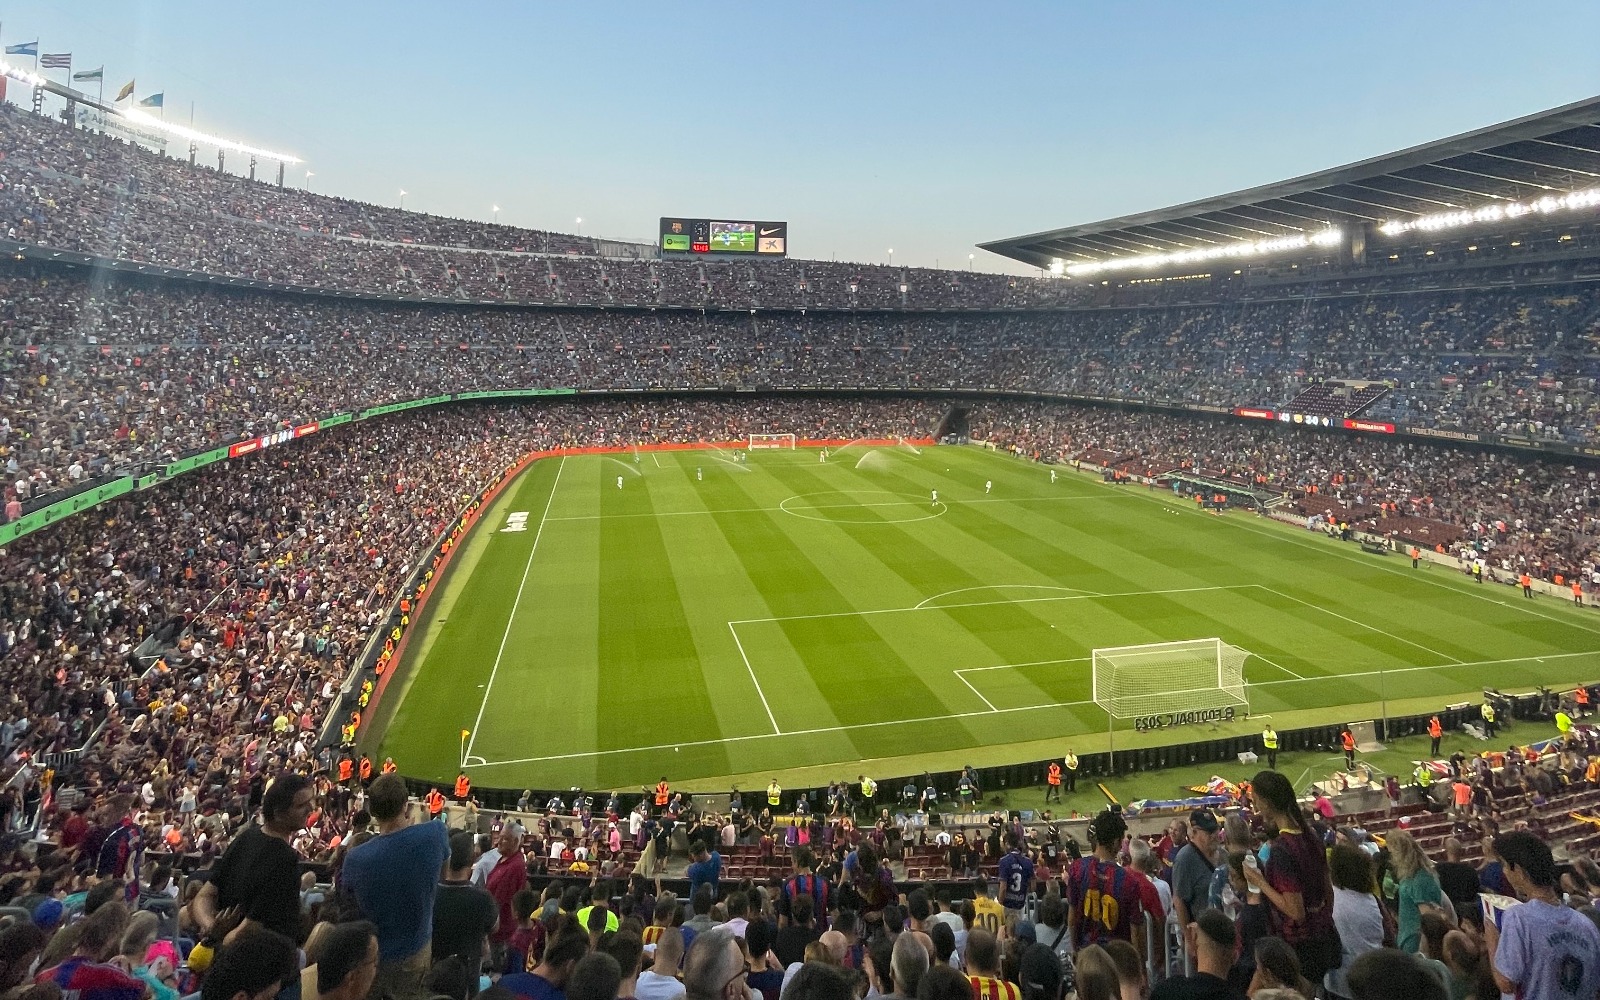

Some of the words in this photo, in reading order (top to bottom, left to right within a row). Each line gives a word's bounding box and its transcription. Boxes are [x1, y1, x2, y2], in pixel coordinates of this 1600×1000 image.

[1010, 872, 1022, 892] 3
[1084, 888, 1119, 931] 10
[976, 912, 998, 934] 10
